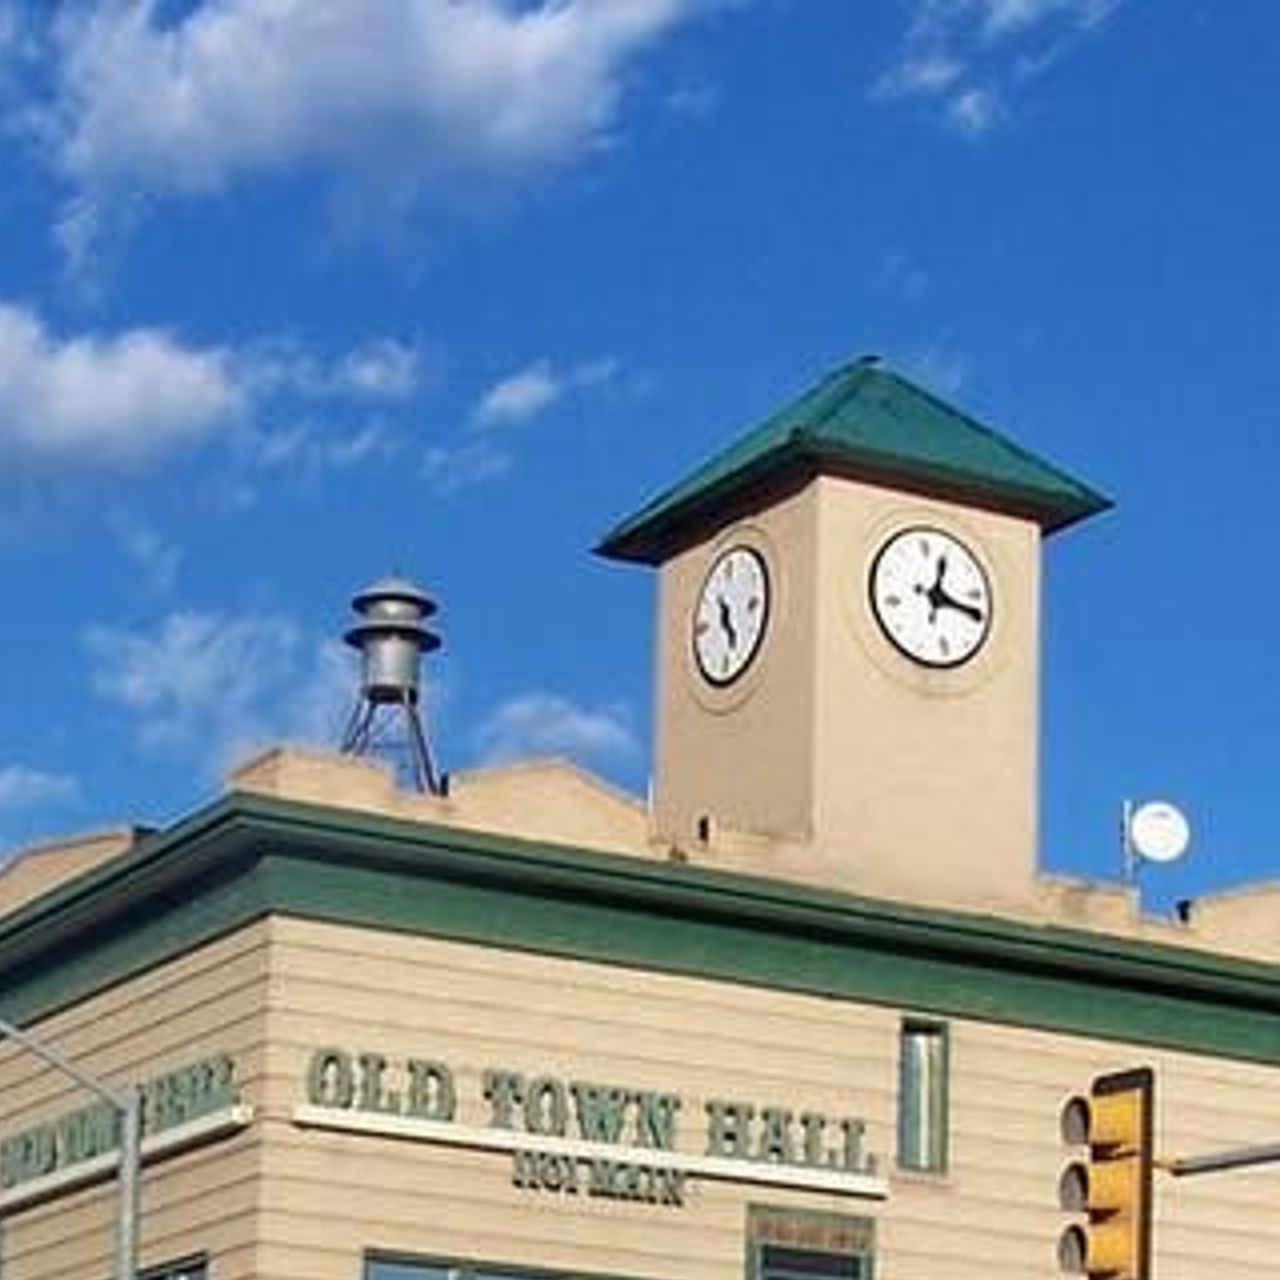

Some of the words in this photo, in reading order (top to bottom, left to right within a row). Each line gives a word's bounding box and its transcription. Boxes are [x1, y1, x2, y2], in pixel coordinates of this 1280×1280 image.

[308, 1047, 457, 1123] OLD
[484, 1067, 682, 1150] TOWN
[705, 1101, 878, 1176] HALL
